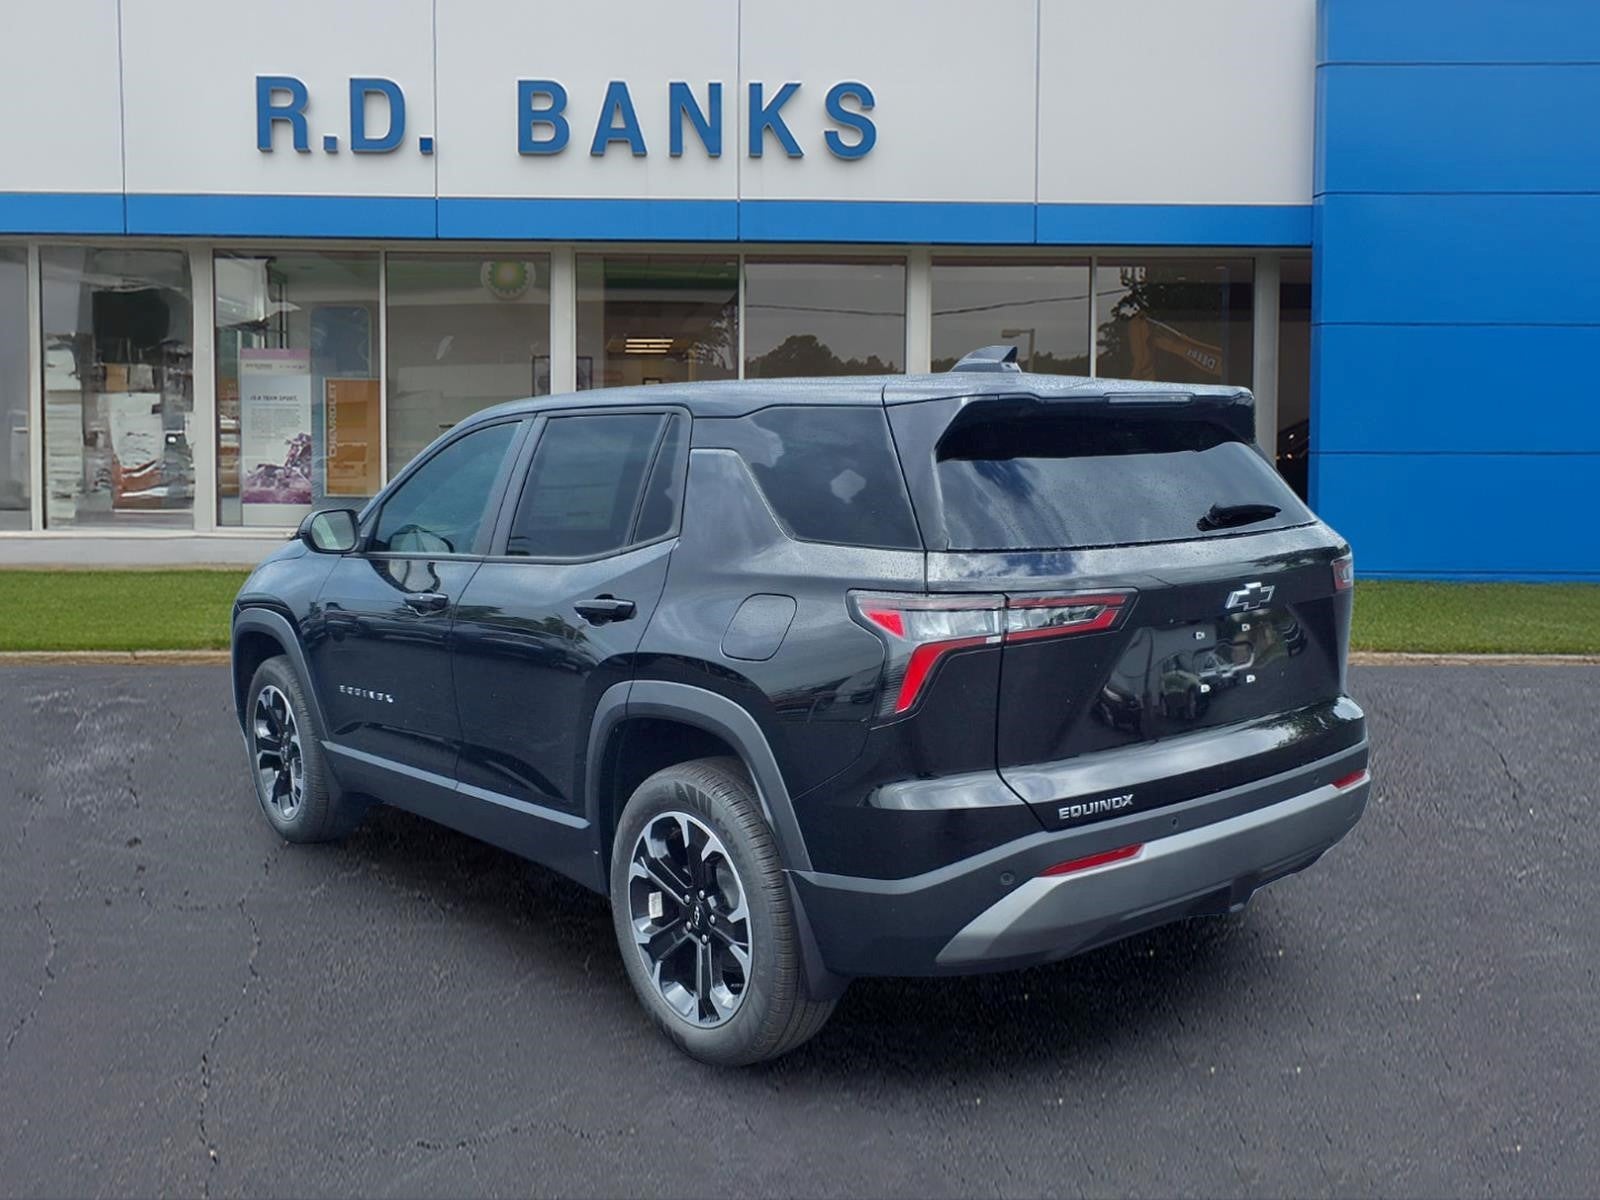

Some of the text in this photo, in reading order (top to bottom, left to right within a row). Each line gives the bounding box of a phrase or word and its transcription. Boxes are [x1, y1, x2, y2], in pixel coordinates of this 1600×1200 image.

[256, 75, 877, 160] R.D. BANKS
[1058, 794, 1134, 820] EQUINOX
